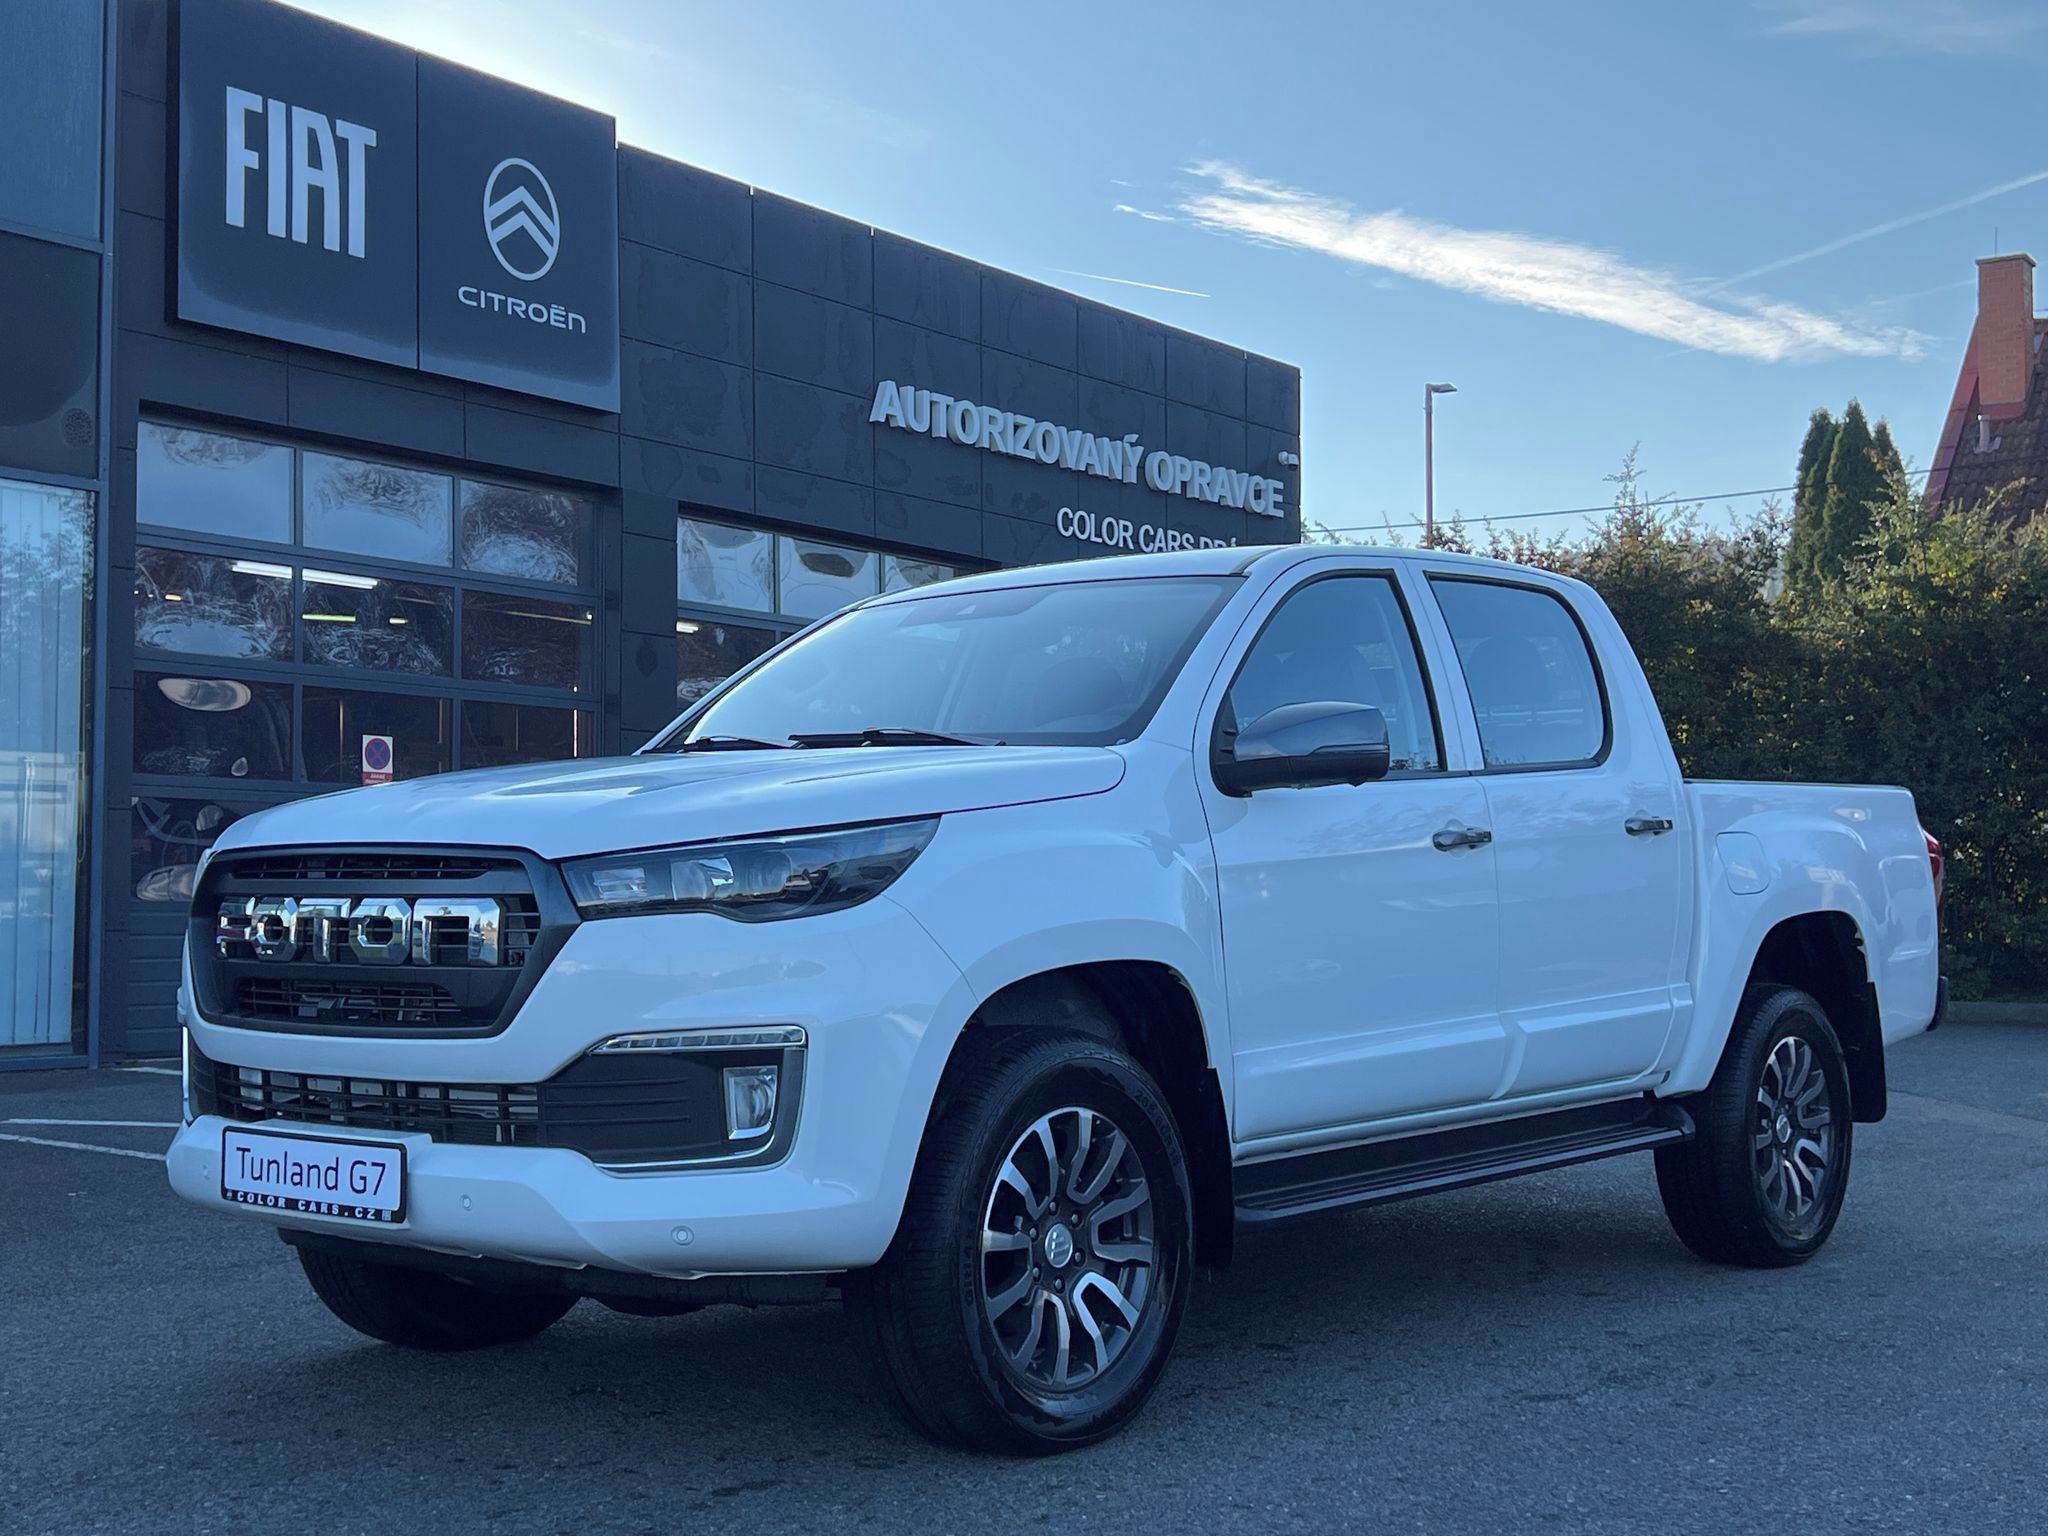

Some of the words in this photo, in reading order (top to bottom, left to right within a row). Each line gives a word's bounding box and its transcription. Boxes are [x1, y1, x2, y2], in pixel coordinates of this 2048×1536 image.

[225, 86, 377, 259] FIAT
[457, 285, 587, 334] CITROËN
[869, 380, 1144, 484] AUTORIZOVANÝ
[1145, 451, 1285, 518] OPRAVCE
[1057, 507, 1134, 549] COLOR
[1138, 524, 1194, 553] CARS
[217, 896, 500, 967] FOTON
[236, 1147, 339, 1191] Tunland
[350, 1160, 387, 1196] G7
[237, 1191, 286, 1208] COLOR
[297, 1200, 376, 1220] CARS.CZ
